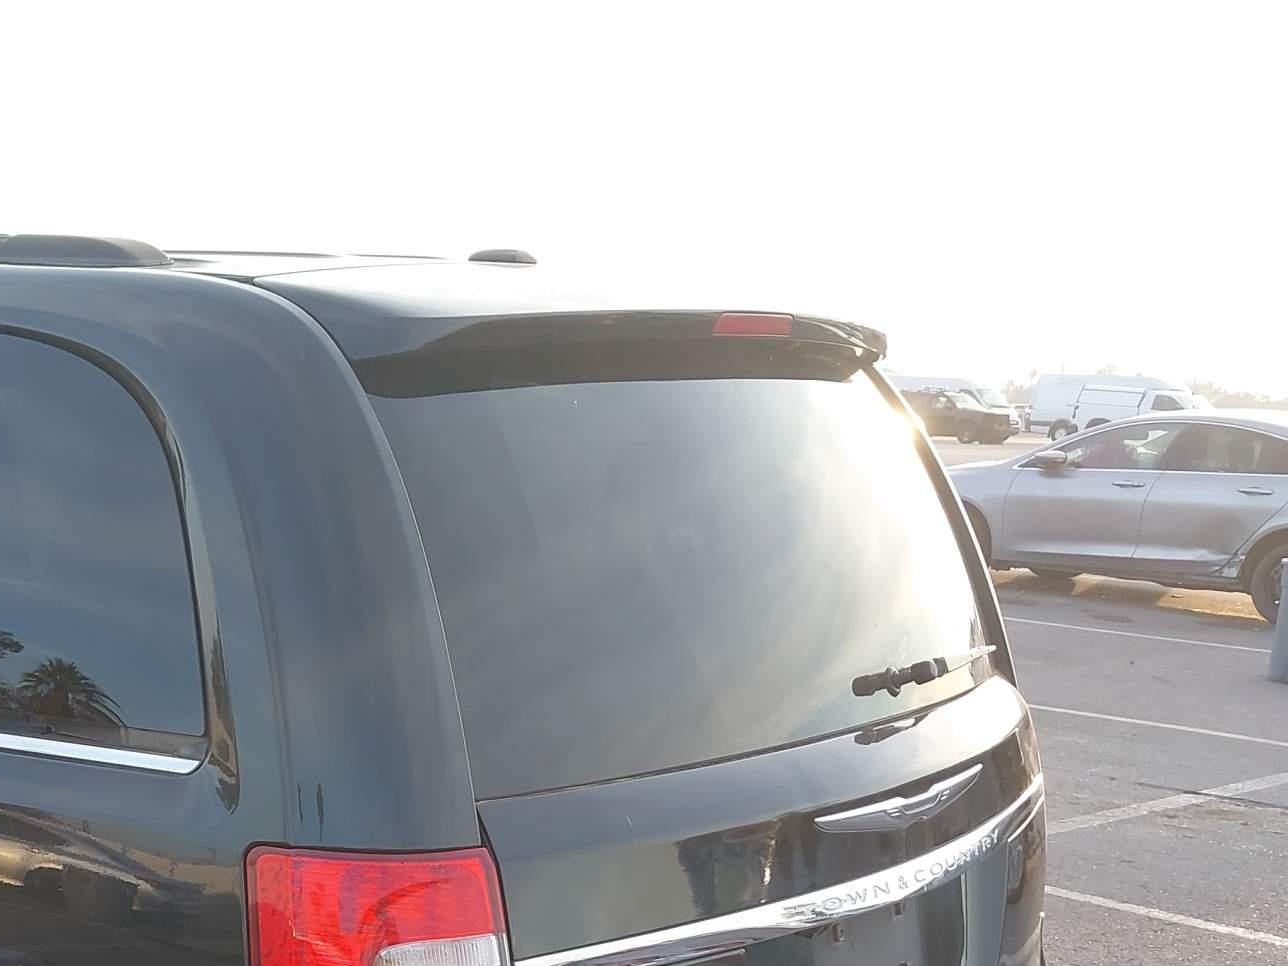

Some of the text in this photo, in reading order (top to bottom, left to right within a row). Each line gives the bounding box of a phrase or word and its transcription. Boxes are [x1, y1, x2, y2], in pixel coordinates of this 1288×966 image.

[802, 828, 1000, 919] TOWN & COUNTRY
